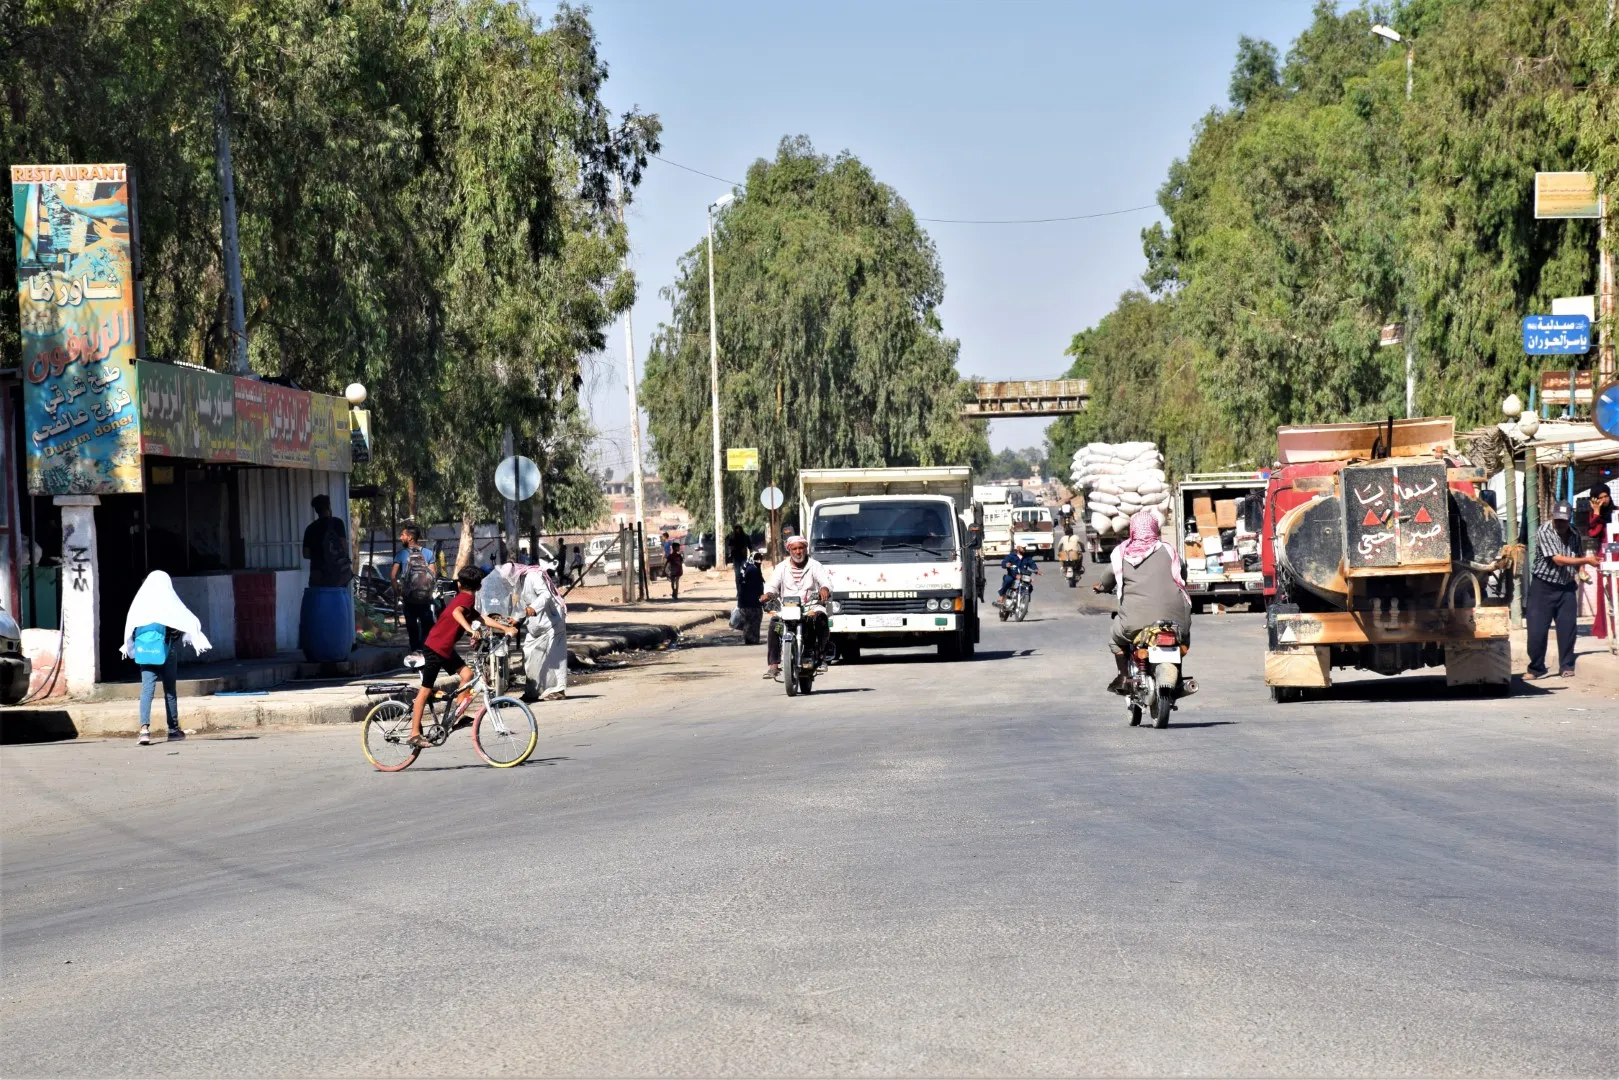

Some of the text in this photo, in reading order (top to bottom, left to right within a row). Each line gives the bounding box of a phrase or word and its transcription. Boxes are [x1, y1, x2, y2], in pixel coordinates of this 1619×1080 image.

[13, 165, 125, 182] RESTAURANT
[28, 272, 122, 306] شاورما
[1537, 316, 1575, 334] صيدلية
[27, 306, 131, 384] الزيزفون
[44, 365, 121, 415] طبخ شرقي
[31, 387, 131, 448] فروج عالفحم
[43, 432, 91, 458] Durum
[94, 413, 134, 437] doner
[1407, 523, 1442, 547] صبر
[848, 591, 918, 599] MITSUBISHI
